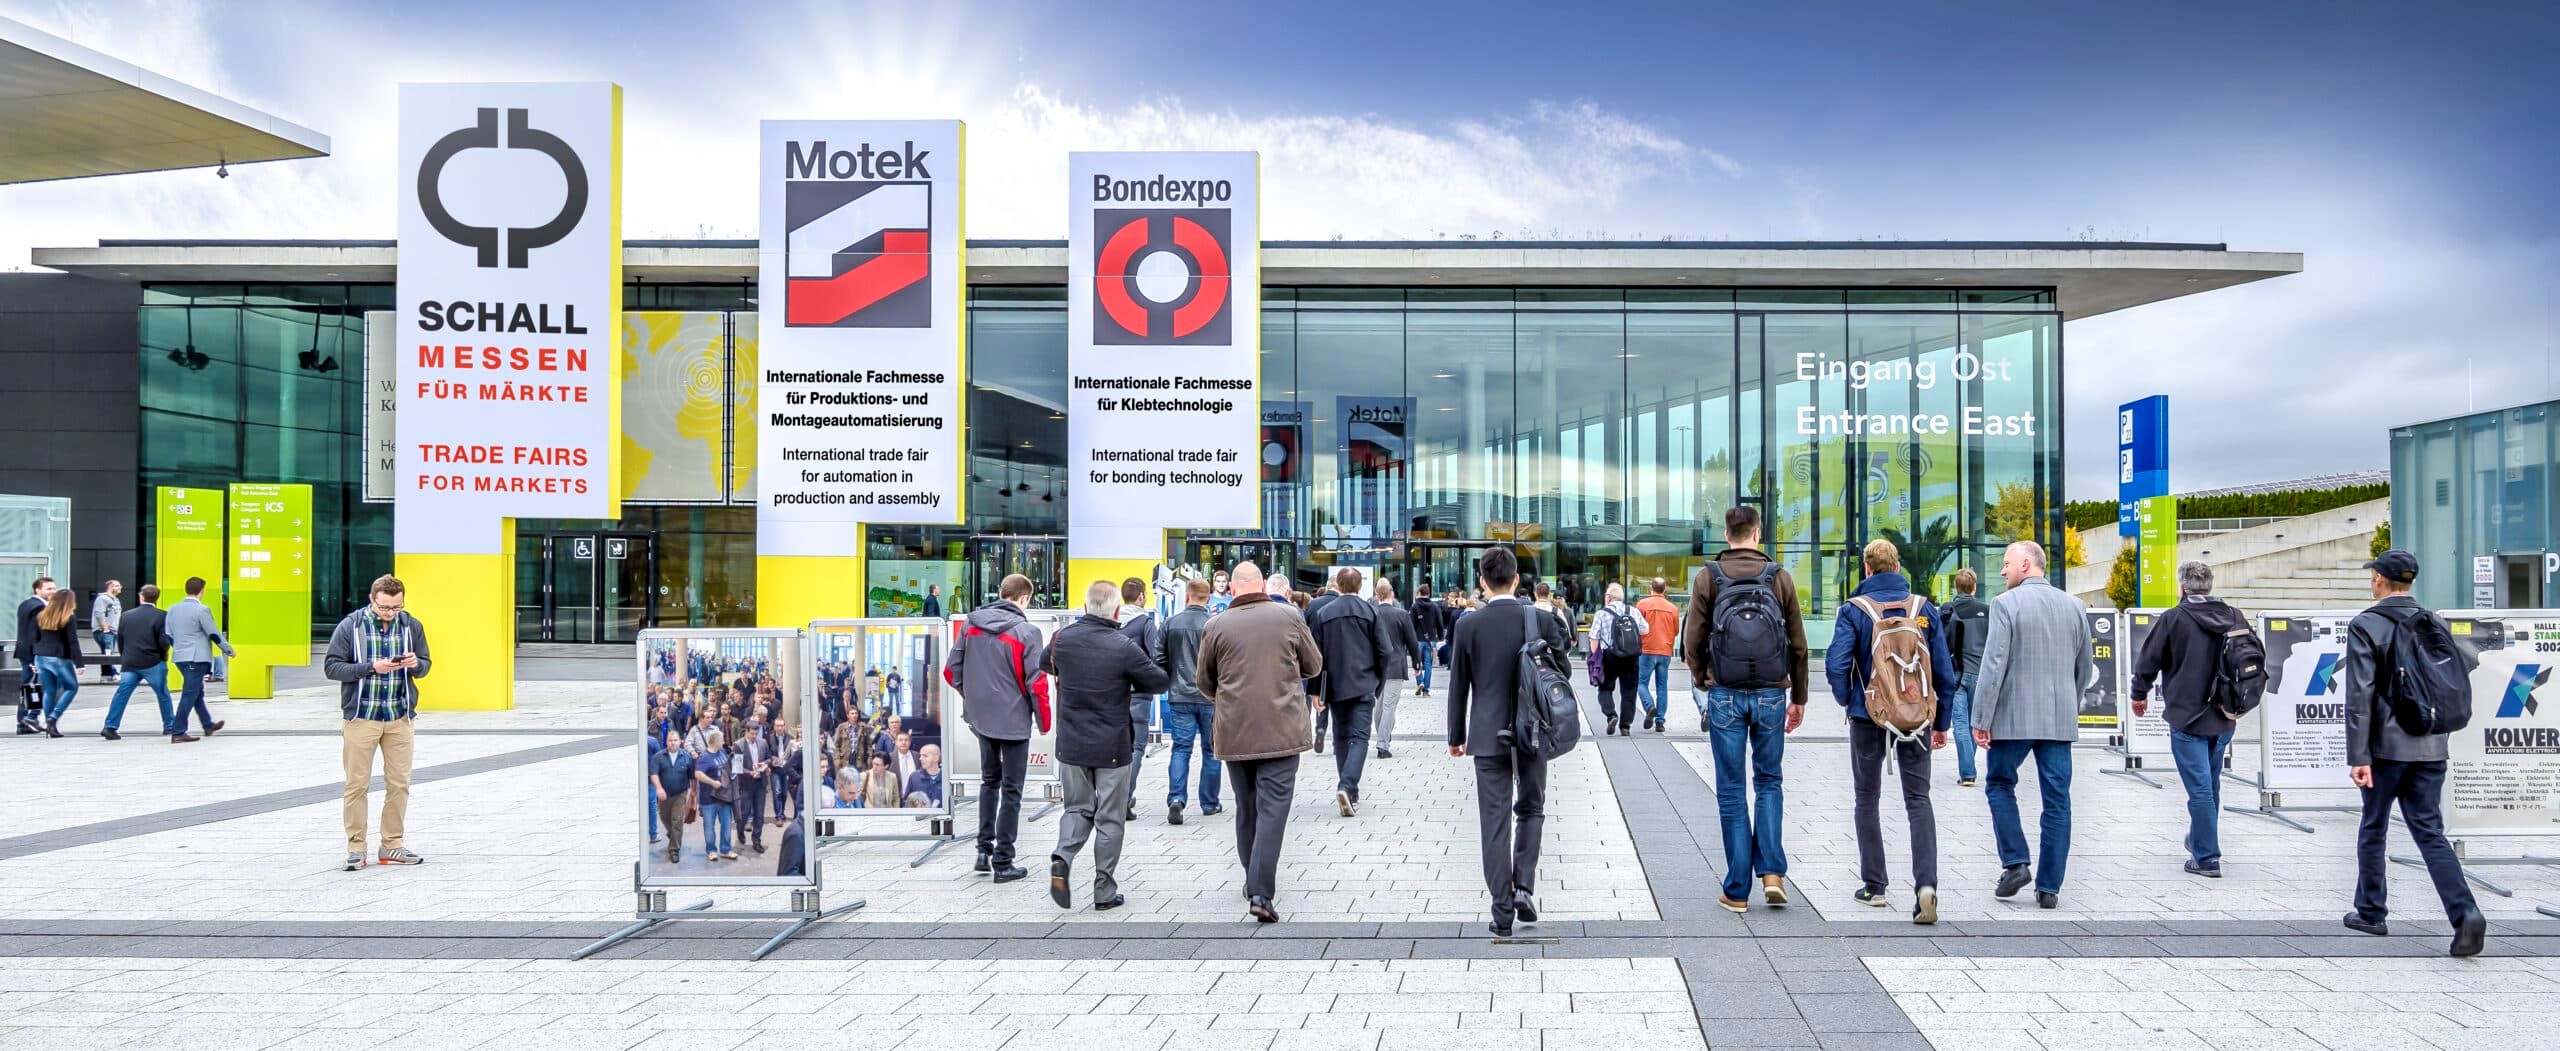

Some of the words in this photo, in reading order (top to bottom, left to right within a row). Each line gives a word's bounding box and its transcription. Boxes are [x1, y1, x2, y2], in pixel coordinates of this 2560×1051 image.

[786, 141, 931, 178] Motek
[1094, 174, 1231, 207] Bondexpo
[418, 301, 587, 335] SCHALL
[419, 345, 586, 371] MESSEN
[767, 370, 862, 383] Internationale
[867, 370, 944, 383] Fachmesse
[1796, 352, 1936, 389] Eingang
[1951, 352, 2012, 382] Ost
[418, 380, 467, 400] FÜR
[480, 381, 587, 402] MÄRKTE
[1075, 376, 1170, 389] Internationale
[1175, 376, 1252, 389] Fachmesse
[786, 392, 806, 405] für
[810, 392, 898, 405] Produktions-
[903, 392, 928, 405] und
[1097, 398, 1117, 411] für
[1122, 398, 1232, 414] Klebtechnologie
[772, 413, 942, 429] Montageautomatisierung
[1796, 406, 1949, 435] Entrance
[1964, 406, 2036, 436] East
[419, 444, 503, 464] TRADE
[514, 446, 587, 466] FAIRS
[783, 448, 864, 461] International
[869, 448, 903, 461] trade
[907, 448, 929, 461] fair
[1092, 448, 1173, 461] International
[1178, 448, 1212, 462] trade
[1216, 448, 1238, 462] fair
[419, 474, 464, 491] FOR
[475, 477, 587, 495] MARKETS
[801, 469, 820, 482] for
[824, 470, 897, 483] automation
[902, 470, 913, 483] in
[1090, 470, 1108, 483] for
[1113, 470, 1165, 487] bonding
[1170, 470, 1242, 487] technology
[264, 501, 284, 513] ICS
[774, 491, 844, 508] production
[849, 491, 873, 504] and
[878, 491, 940, 508] assembly
[2133, 500, 2140, 521] B
[2336, 635, 2346, 644] 30
[2092, 646, 2111, 658] ER
[2296, 704, 2345, 719] KOLVE
[2484, 728, 2560, 747] KOLVER
